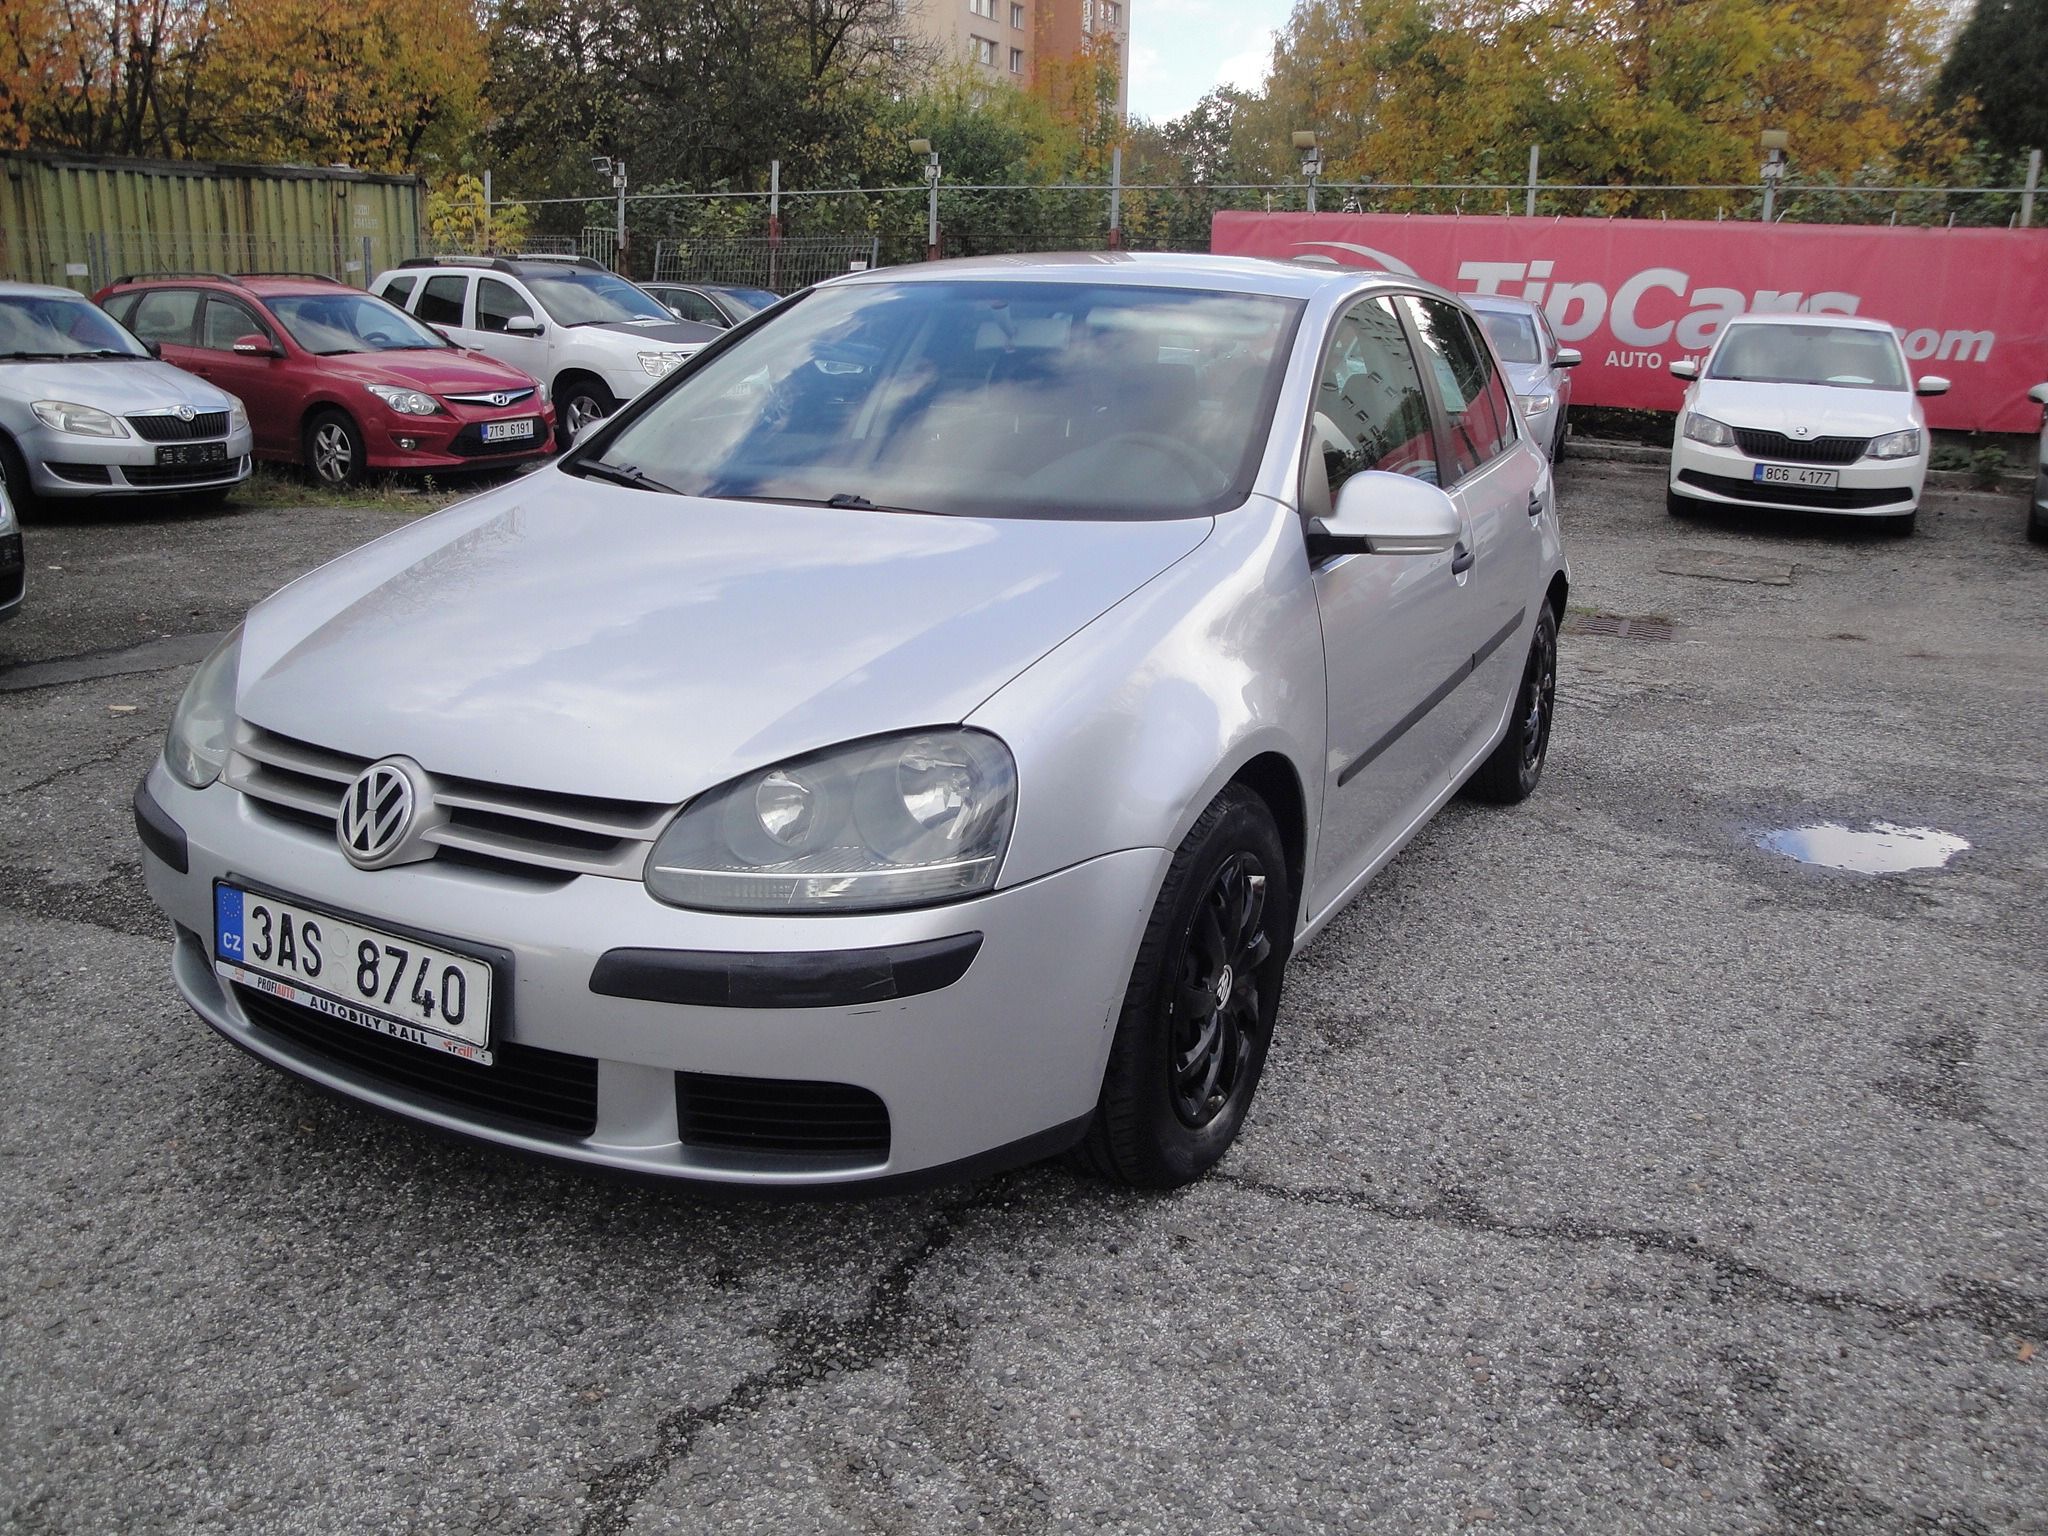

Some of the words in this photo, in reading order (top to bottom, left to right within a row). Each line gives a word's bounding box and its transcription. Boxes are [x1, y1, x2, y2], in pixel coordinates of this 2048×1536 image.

[1605, 350, 1662, 369] AUTO
[489, 425, 505, 438] 7T9
[510, 422, 530, 435] 6191
[1766, 467, 1790, 481] 8C6
[1799, 470, 1832, 485] 4177
[222, 932, 241, 952] CZ
[251, 905, 323, 978] 3AS
[357, 938, 466, 1026] 8740
[257, 977, 296, 1000] PROFIAUTO
[388, 1023, 428, 1046] RALL
